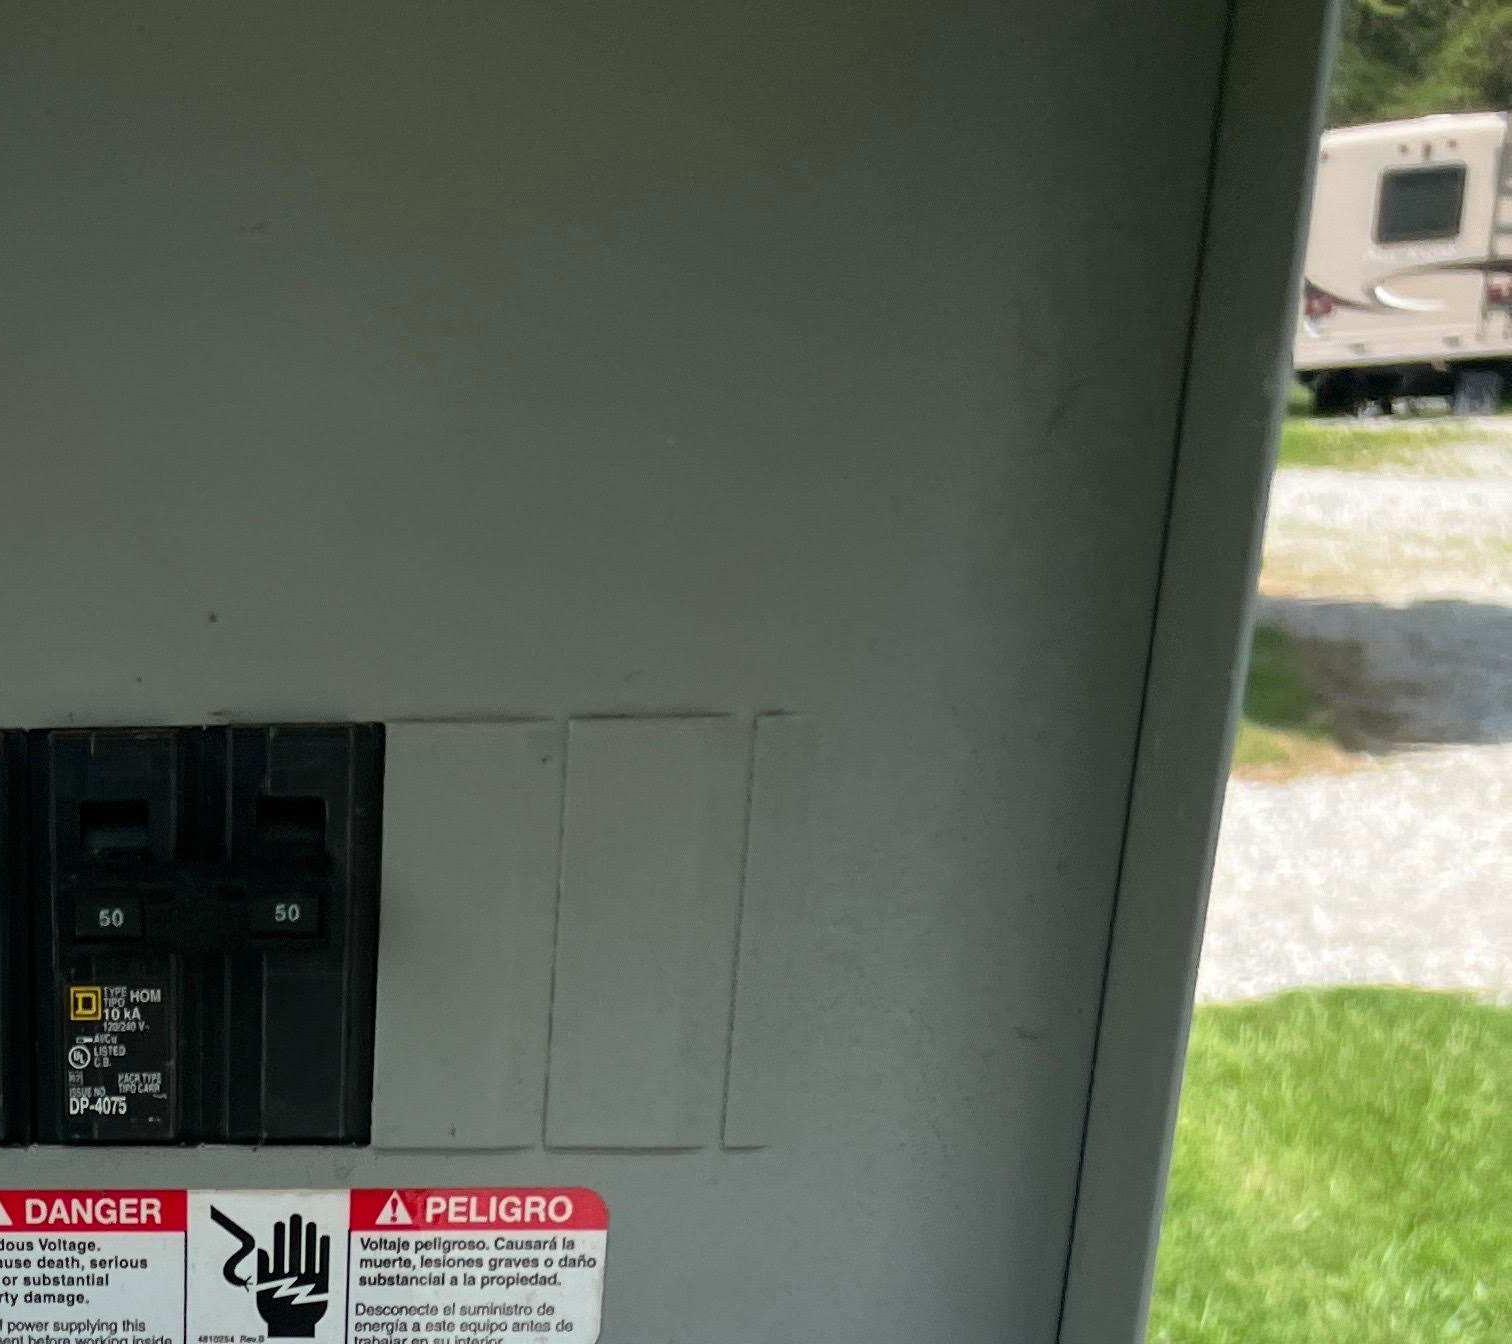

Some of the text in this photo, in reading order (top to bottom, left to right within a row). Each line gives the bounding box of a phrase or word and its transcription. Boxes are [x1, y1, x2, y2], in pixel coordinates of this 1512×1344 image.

[274, 903, 301, 923] 50
[129, 989, 162, 1003] HOM
[104, 1007, 141, 1021] 10 kA
[93, 1046, 127, 1057] LISTED
[69, 1095, 128, 1115] DP-4075
[25, 1198, 163, 1225] DANGER
[425, 1195, 573, 1224] PELIGRO
[38, 1238, 101, 1254] Voltage.
[360, 1236, 575, 1254] Voltaje peligroso. Causará la
[37, 1256, 85, 1271] death,
[90, 1256, 148, 1270] serious
[360, 1255, 597, 1271] muerte, lesiones graves o daño
[1, 1276, 18, 1287] or
[23, 1273, 109, 1287] substantial
[358, 1273, 562, 1289] substancial a la propiedad.
[23, 1291, 90, 1307] damage.
[355, 1303, 555, 1317] Desconecte el suministro de
[7, 1321, 49, 1336] power
[53, 1319, 118, 1336] supplying
[122, 1319, 146, 1332] this
[354, 1319, 574, 1336] energía a este equipo antes de
